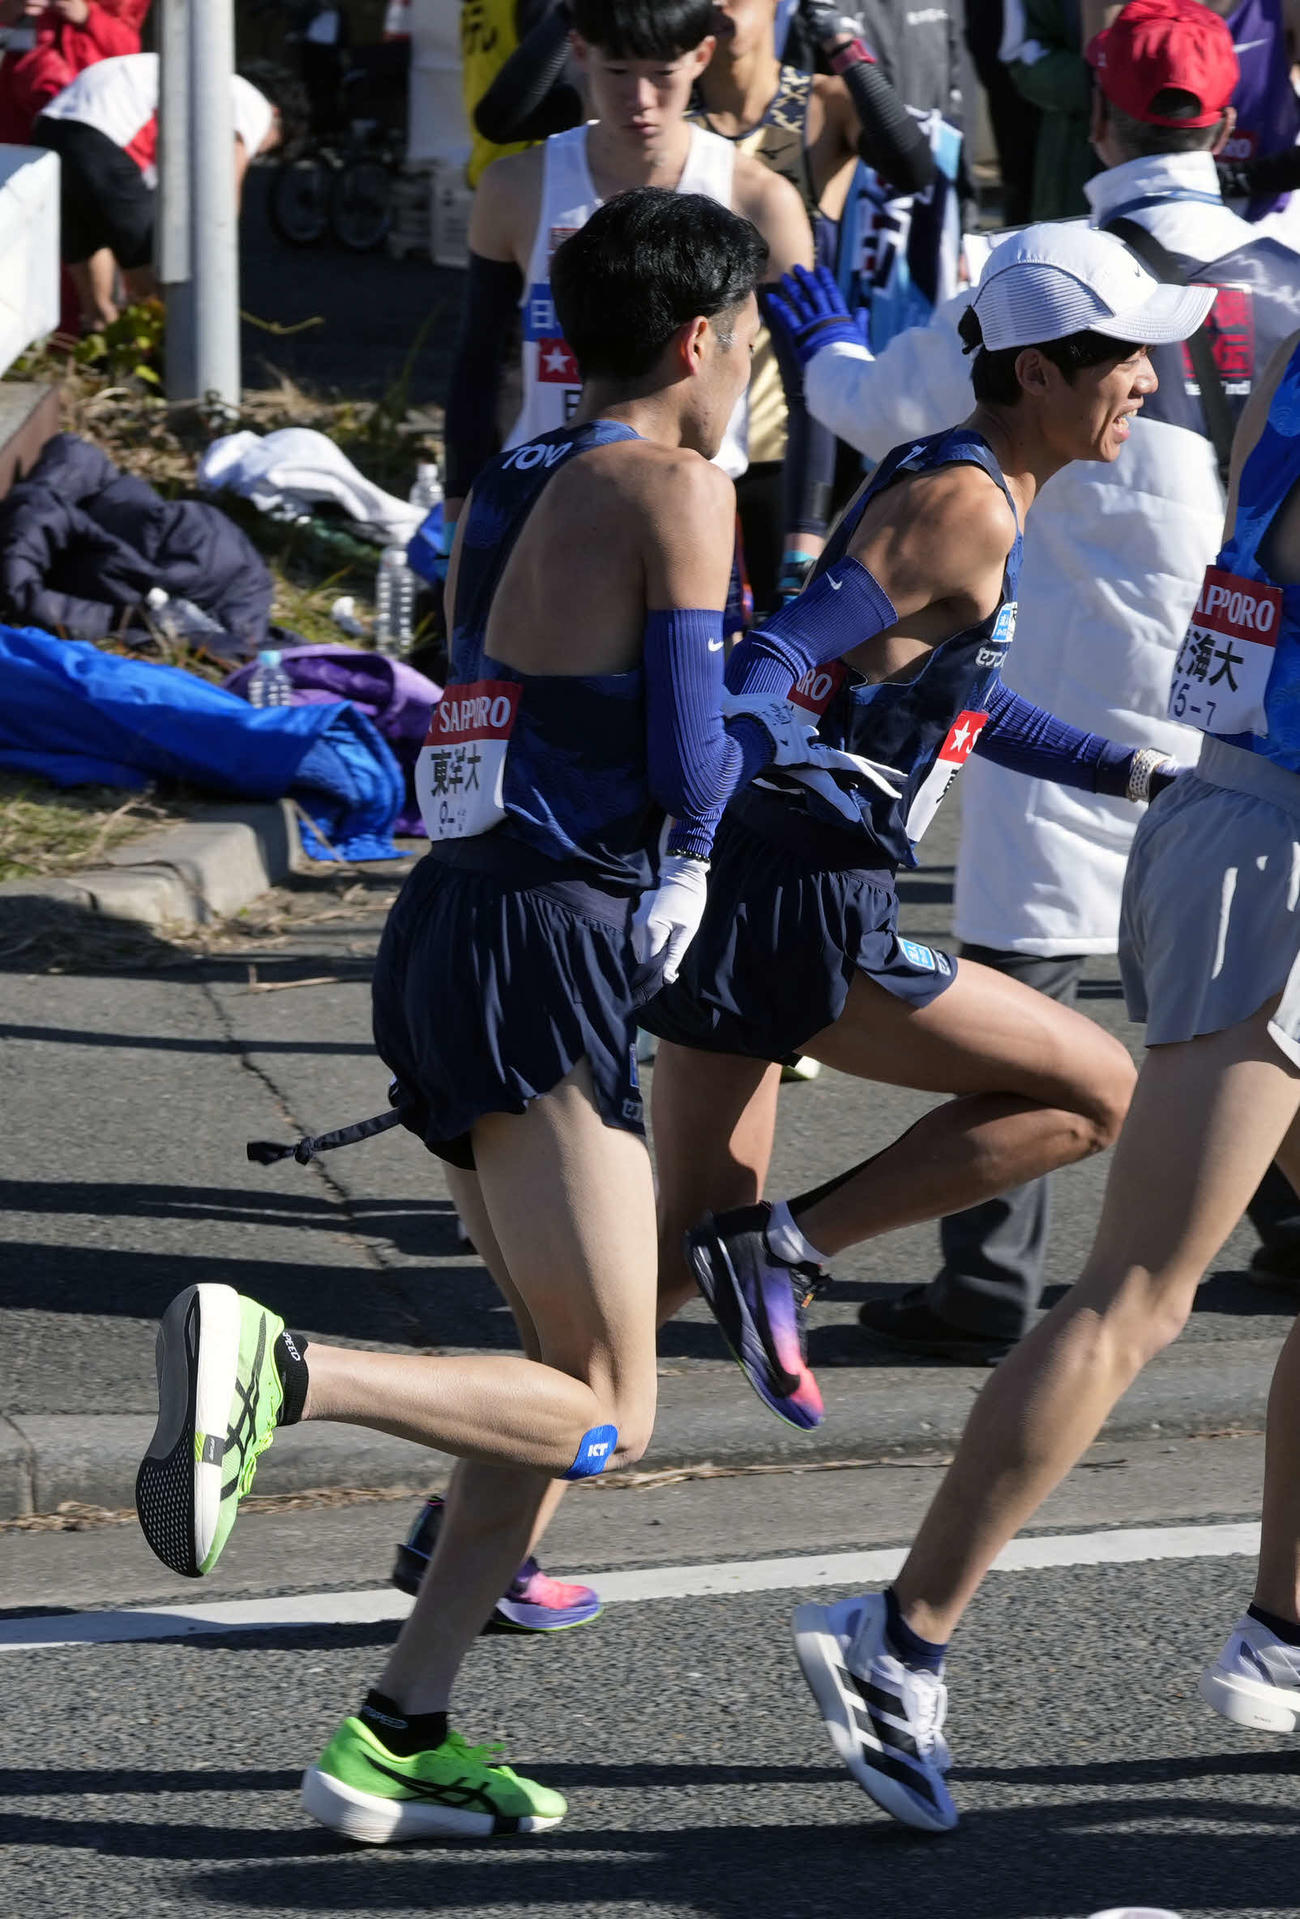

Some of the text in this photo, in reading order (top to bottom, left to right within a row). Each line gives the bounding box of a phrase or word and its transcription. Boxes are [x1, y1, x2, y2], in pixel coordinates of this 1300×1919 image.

[430, 744, 481, 797] 東洋大
[587, 1442, 609, 1457] KT
